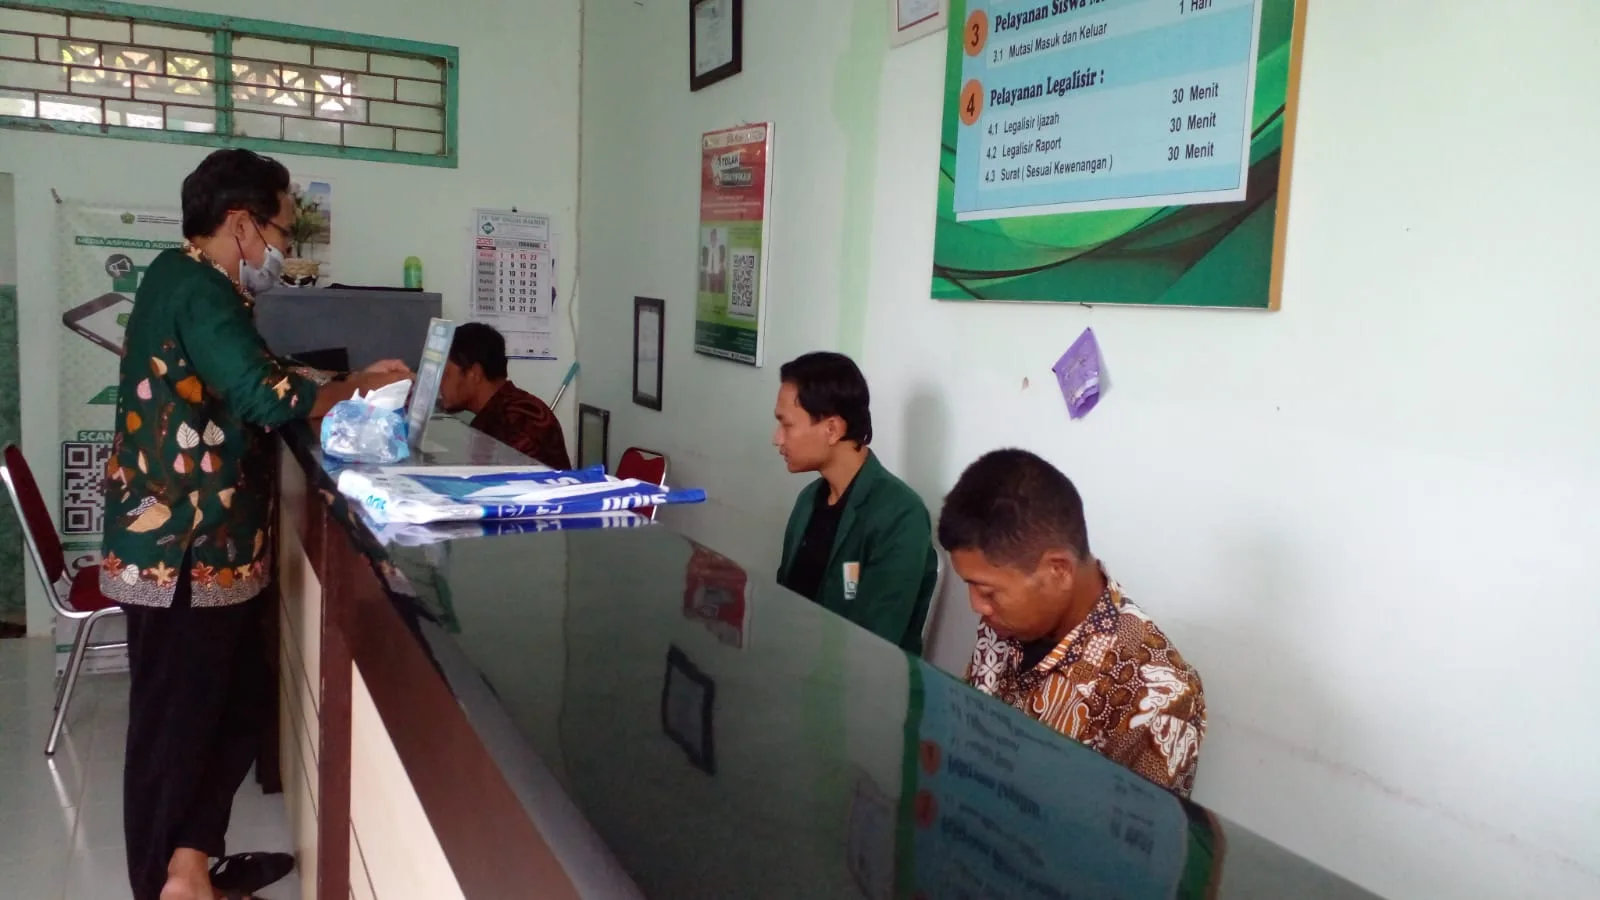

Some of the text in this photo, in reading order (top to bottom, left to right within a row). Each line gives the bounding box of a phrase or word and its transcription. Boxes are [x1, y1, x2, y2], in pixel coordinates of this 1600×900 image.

[1179, 0, 1184, 14] 1
[994, 6, 1049, 33] Pelayanan
[971, 24, 980, 47] 3
[993, 23, 1108, 63] 3.1 Mutasi Masuk dan Keluar
[990, 83, 1043, 107] Pelayanan
[1046, 68, 1097, 97] Legalisir
[1171, 82, 1219, 105] 30 Menit
[966, 93, 976, 116] 4
[988, 112, 1060, 135] 4.1 Legalisir Ijazah
[1169, 112, 1216, 133] 30 Menit
[986, 137, 1062, 159] 4.2 Legalisir Raport
[1167, 141, 1214, 161] 30 Menit
[985, 170, 995, 183] 4.3
[1000, 167, 1020, 181] Surat
[1054, 157, 1107, 175] Kewenangan
[77, 237, 104, 245] MEDIA
[106, 239, 143, 247] ASPIRASI
[80, 431, 114, 442] SCAN
